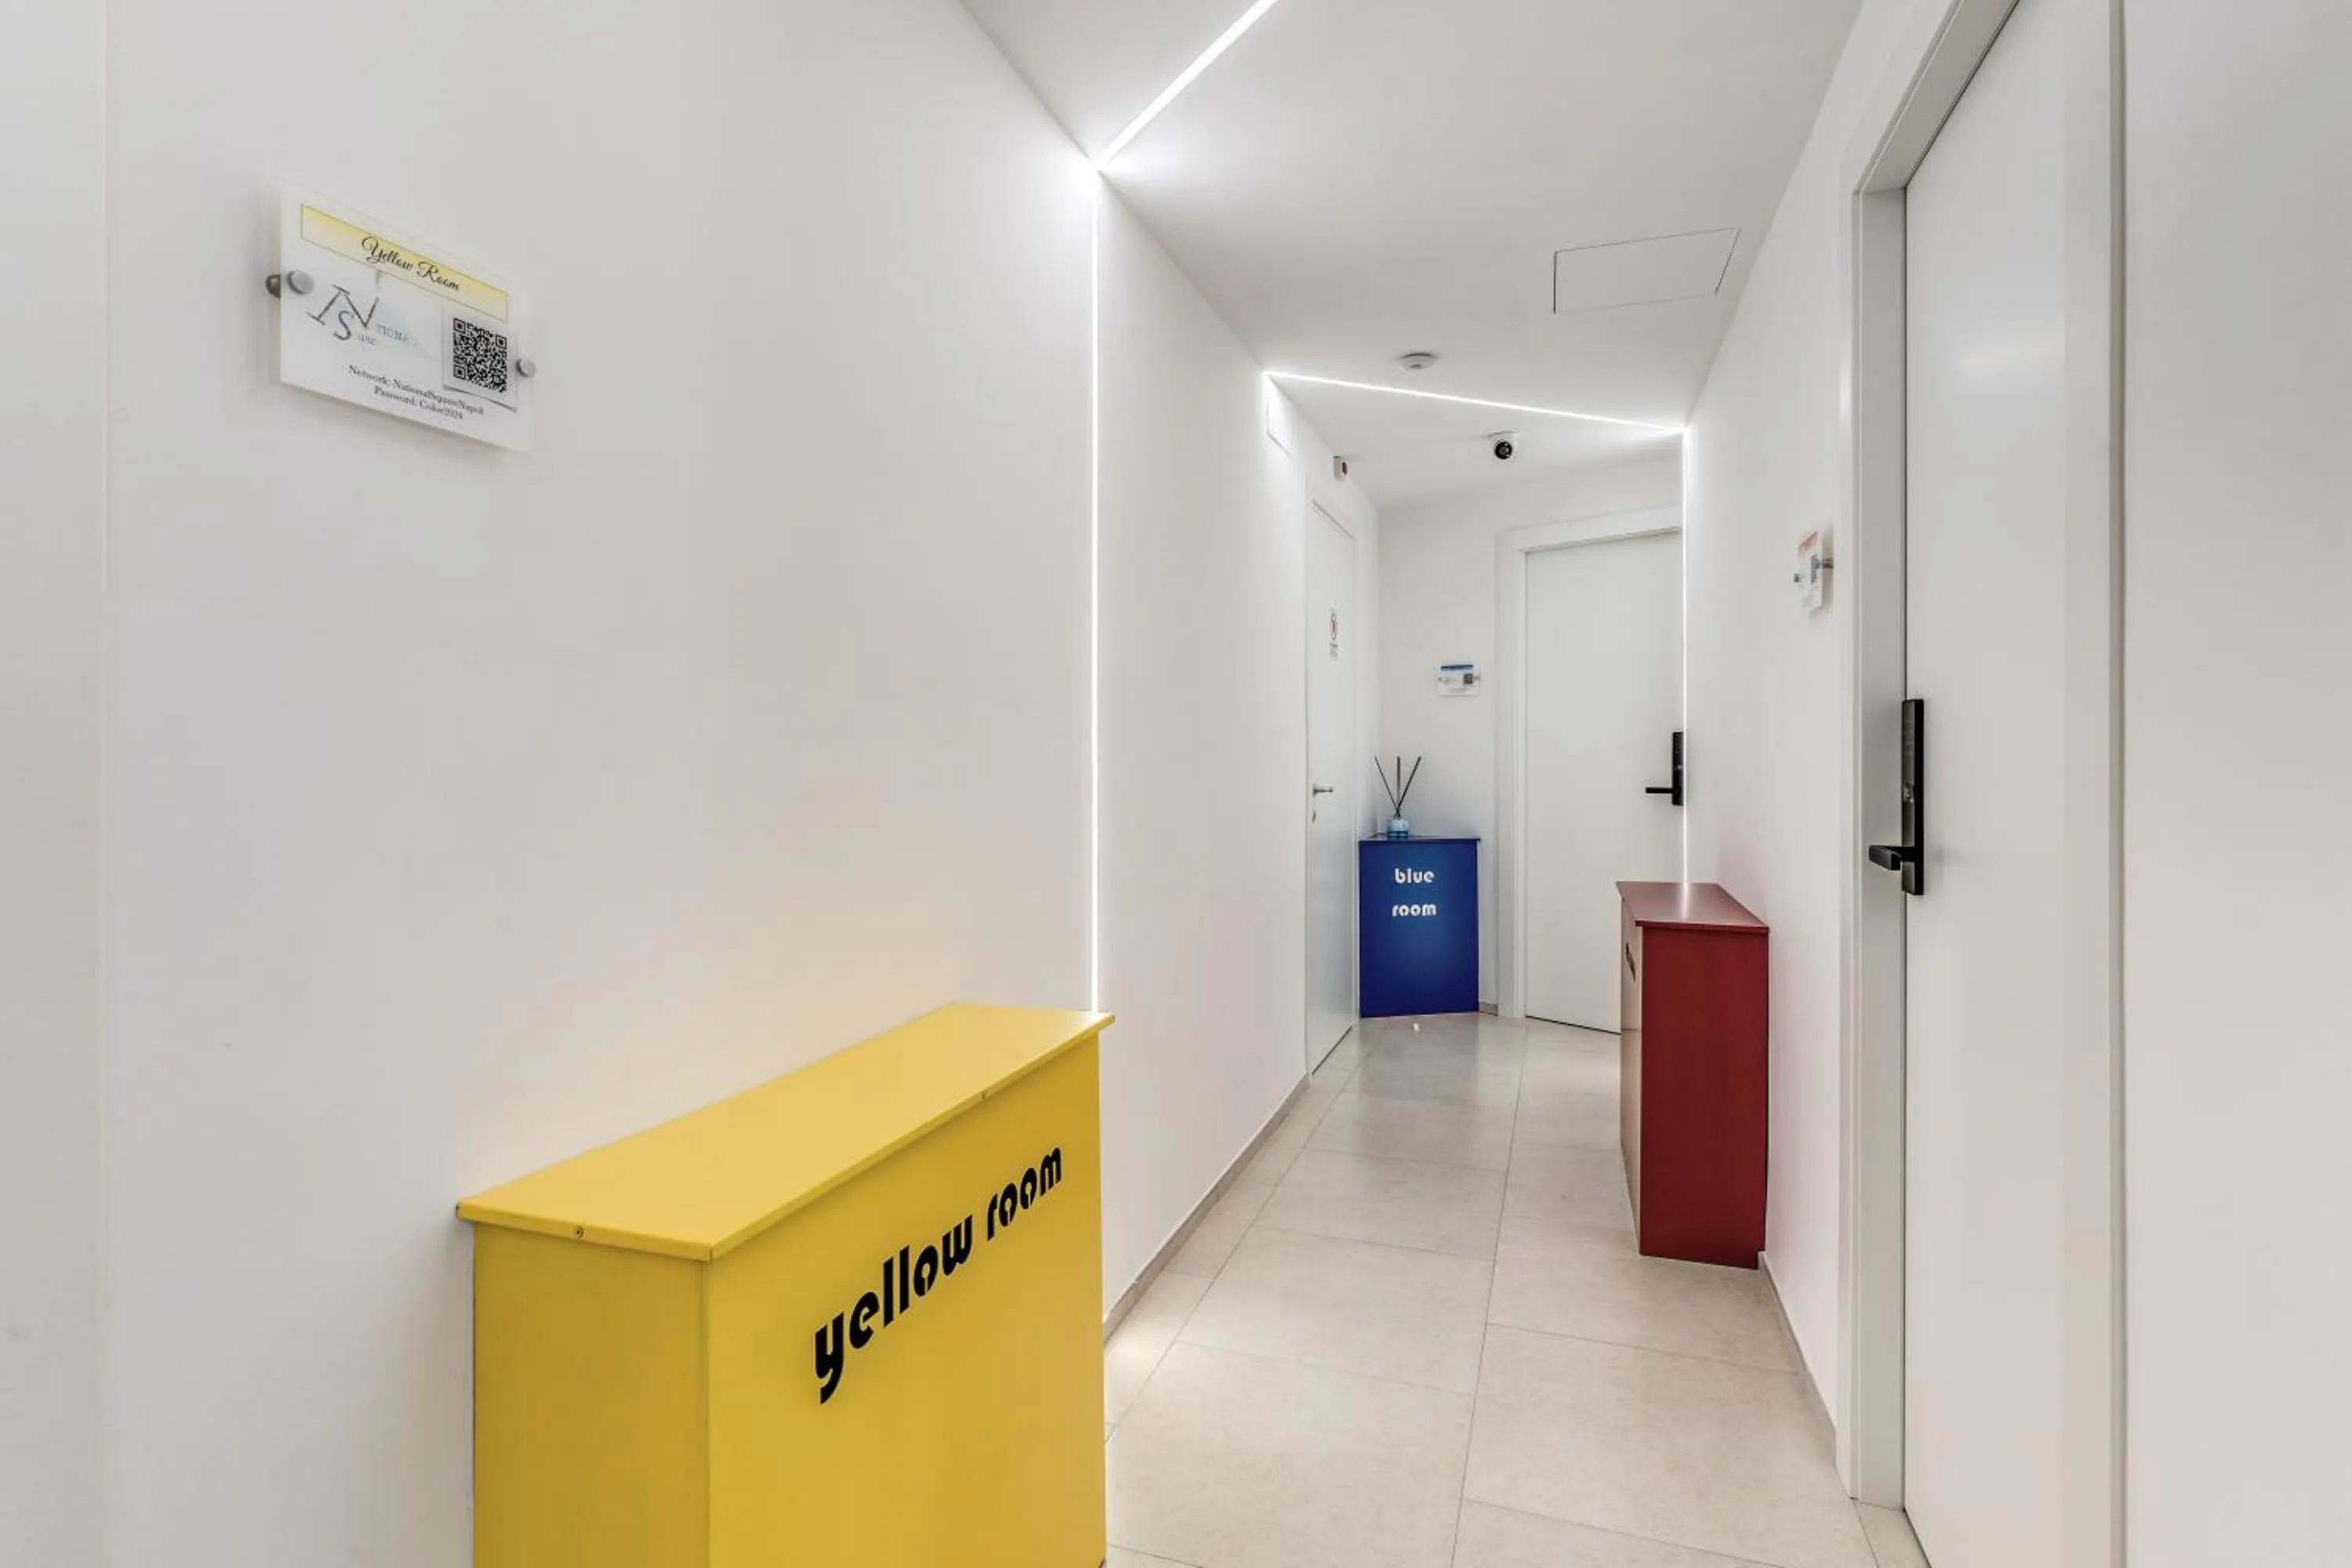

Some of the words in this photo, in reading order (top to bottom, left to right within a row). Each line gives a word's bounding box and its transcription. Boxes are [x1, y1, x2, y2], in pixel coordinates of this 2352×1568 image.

[361, 236, 413, 270] Yellow
[416, 261, 459, 290] Room
[1395, 867, 1435, 884] blue
[1392, 903, 1437, 917] room
[815, 1213, 973, 1405] yellow
[987, 1147, 1062, 1242] room
